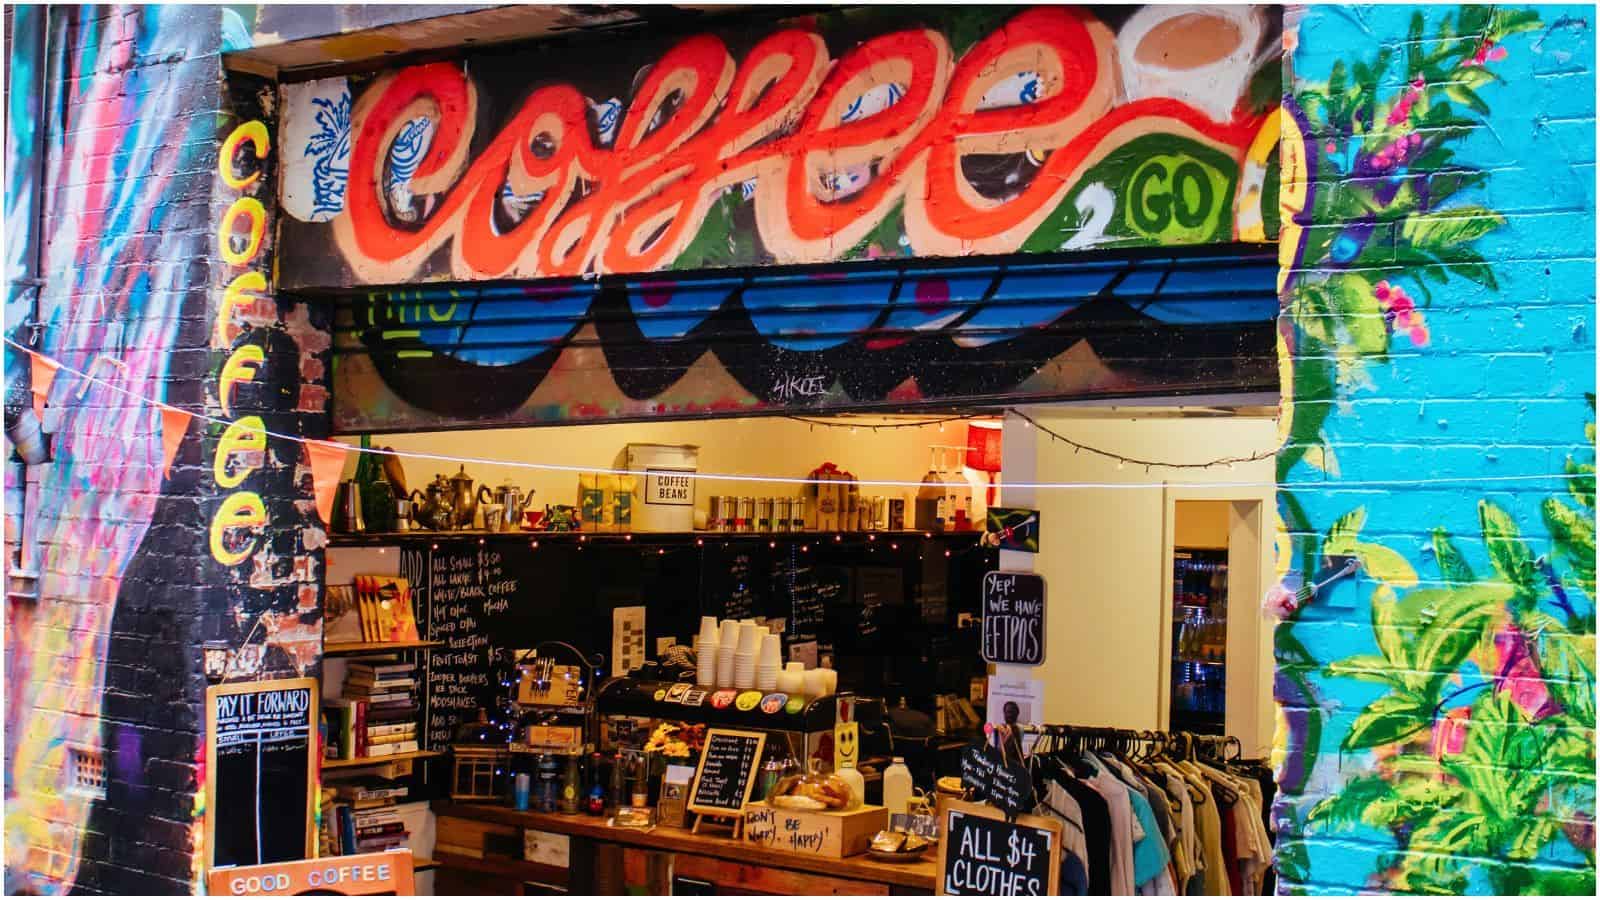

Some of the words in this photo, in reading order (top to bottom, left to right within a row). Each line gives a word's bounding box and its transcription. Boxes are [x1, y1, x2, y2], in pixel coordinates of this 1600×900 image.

[340, 8, 1250, 282] Coffee
[1131, 162, 1213, 234] GO
[657, 475, 689, 488] COFFEE
[658, 488, 688, 500] BEANS
[433, 557, 447, 573] ALL
[433, 573, 447, 586] ALL
[488, 581, 518, 596] COFFEE
[988, 574, 1016, 596] YEP!
[990, 596, 1010, 613] WE
[1014, 599, 1043, 617] HAVE
[985, 615, 1040, 662] EFTPOS
[216, 695, 238, 720] PAY
[240, 693, 256, 717] IT
[257, 689, 309, 713] FORWARD
[746, 808, 776, 825] DON'T
[785, 817, 800, 831] BE
[960, 826, 1000, 861] ALL
[1007, 829, 1037, 871] $4
[230, 873, 290, 895] GOOD
[307, 863, 391, 887] COFFEE
[952, 859, 1040, 896] CLOTHES
